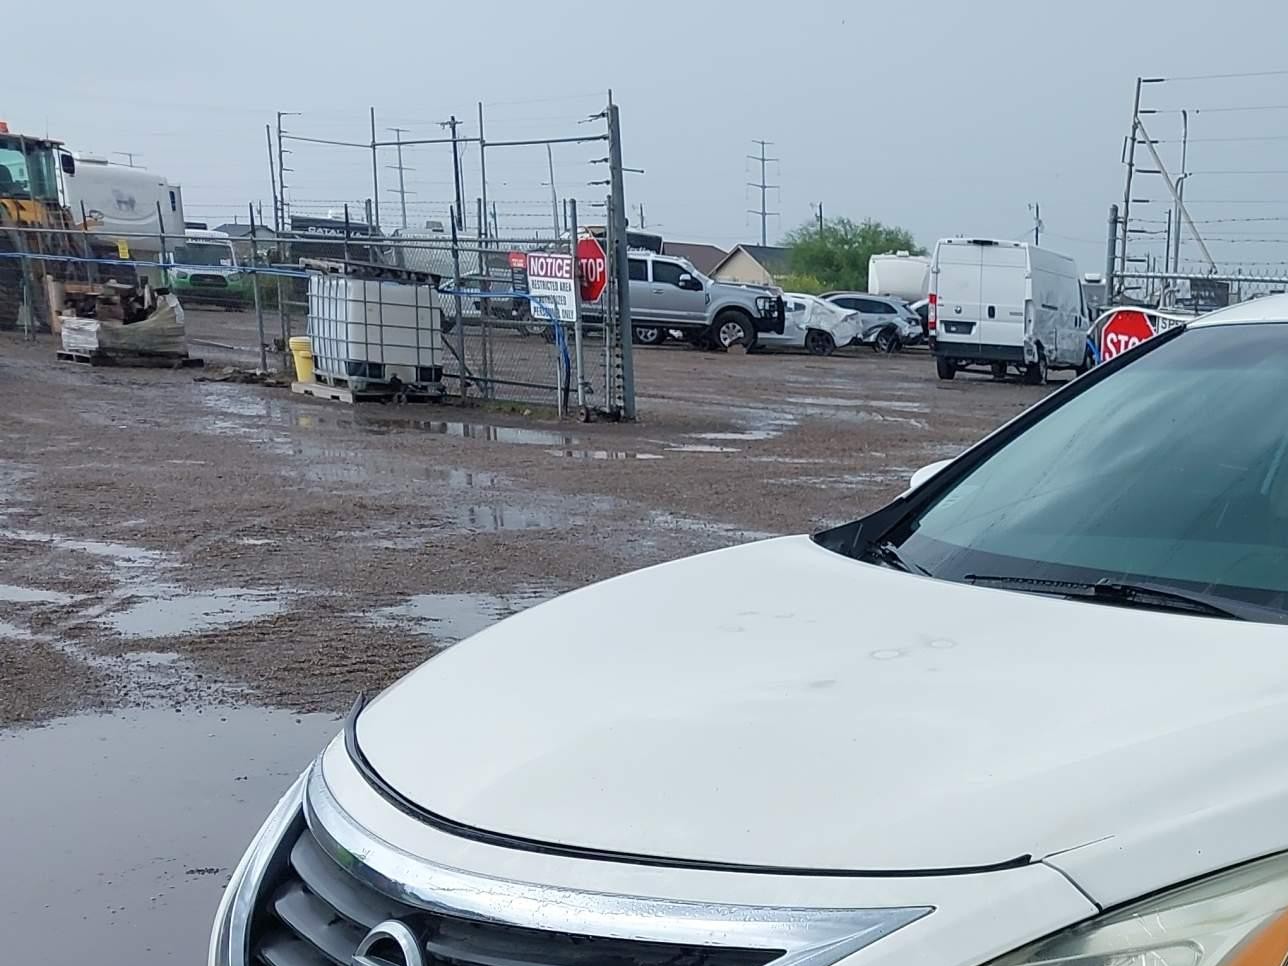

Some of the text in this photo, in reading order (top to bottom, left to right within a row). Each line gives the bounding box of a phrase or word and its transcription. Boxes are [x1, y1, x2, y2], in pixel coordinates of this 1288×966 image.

[530, 257, 571, 278] NOTICE
[580, 258, 604, 282] TOP
[531, 280, 559, 291] RESTRICTED
[560, 281, 572, 292] AREA
[562, 309, 574, 319] ONLY
[1105, 332, 1146, 360] ST
